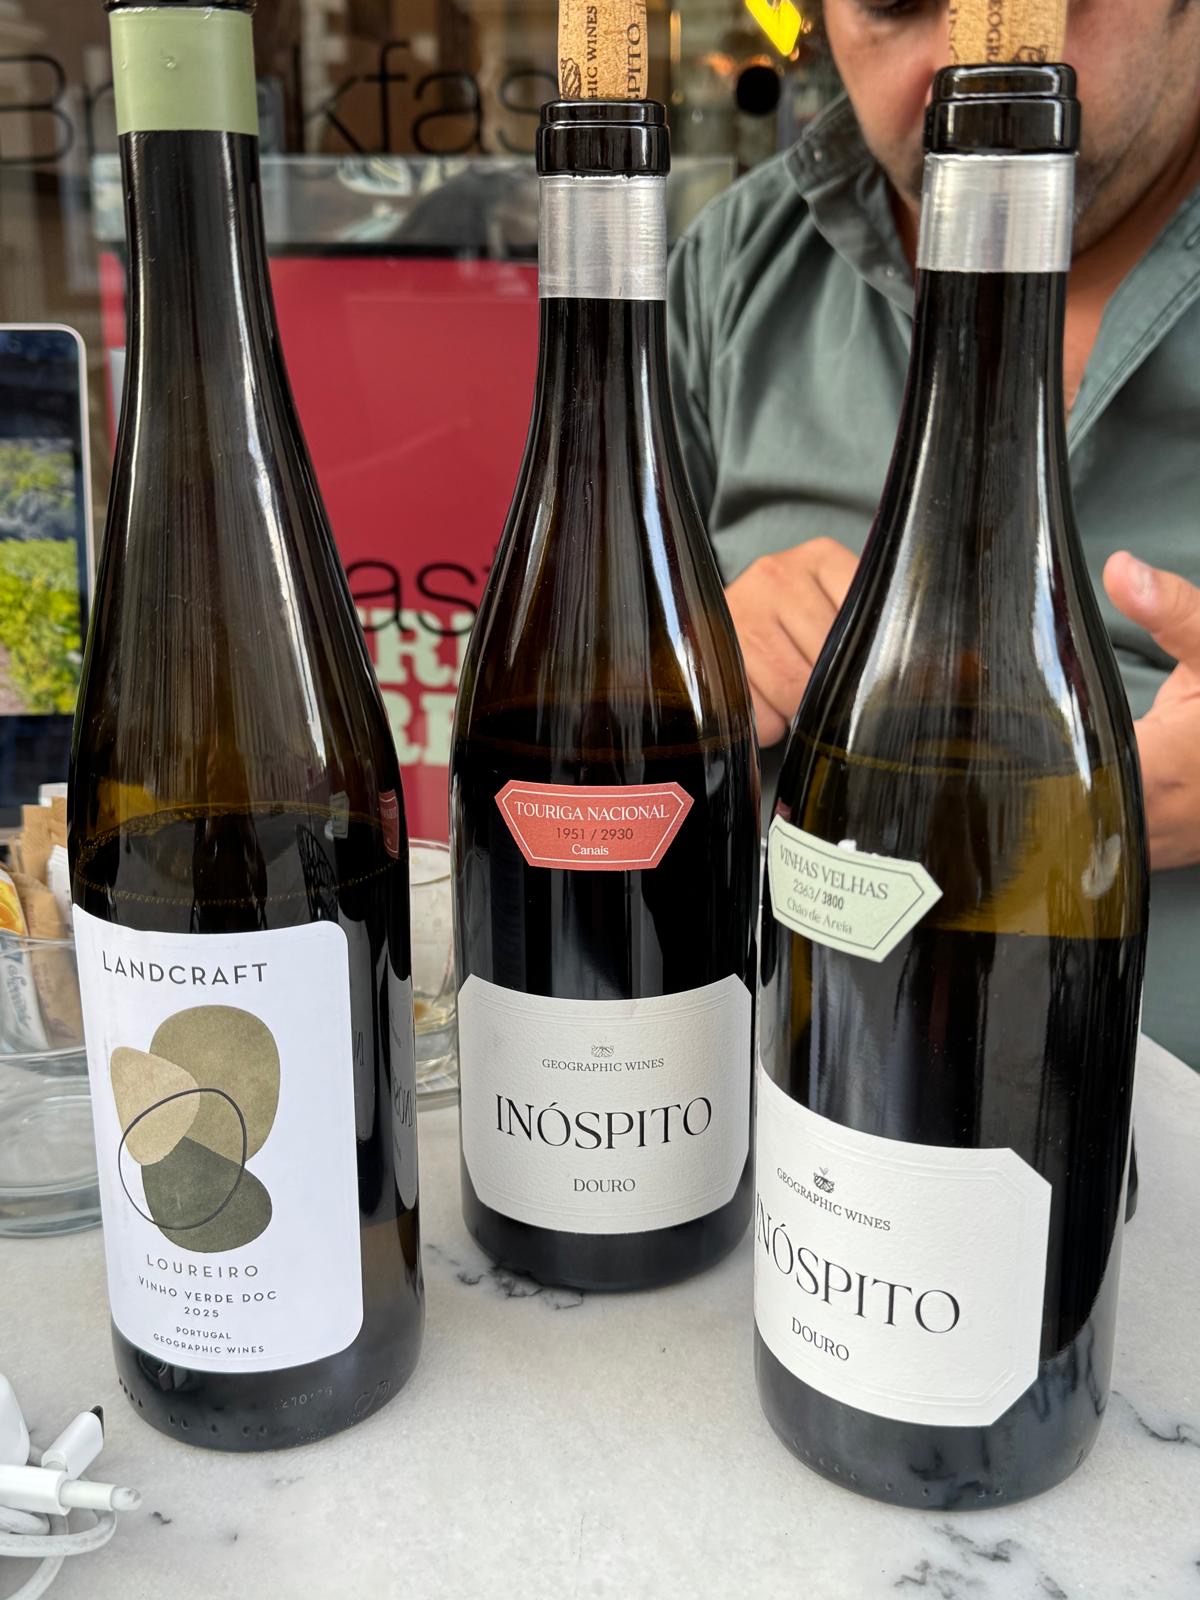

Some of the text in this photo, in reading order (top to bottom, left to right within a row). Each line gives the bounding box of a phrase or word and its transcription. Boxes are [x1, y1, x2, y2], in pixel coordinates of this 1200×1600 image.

[586, 5, 598, 61] WINES
[626, 23, 642, 98] PITO
[514, 801, 670, 821] TOURIGA NACIONAL
[556, 827, 585, 840] 1951
[600, 827, 634, 841] 2930
[571, 843, 609, 856] Canais
[779, 844, 889, 901] VINHAS VELHAS
[808, 909, 820, 922] de
[822, 914, 853, 935] Areia
[102, 950, 268, 986] LANDCRAFT
[541, 1057, 665, 1073] GEOGRAPHIC WINES
[495, 1094, 713, 1150] INÓSPITO
[573, 1178, 636, 1193] DOURO
[776, 1167, 892, 1232] GEOGRAPHIC WINES
[146, 1253, 259, 1279] LOUREIRO
[138, 1275, 278, 1304] VINHO VERDE DOC
[184, 1306, 220, 1318] 2025
[153, 1333, 265, 1354] GEOGRAPHIC WINES
[176, 1326, 232, 1341] PORTUGAL
[791, 1316, 851, 1363] DOURO
